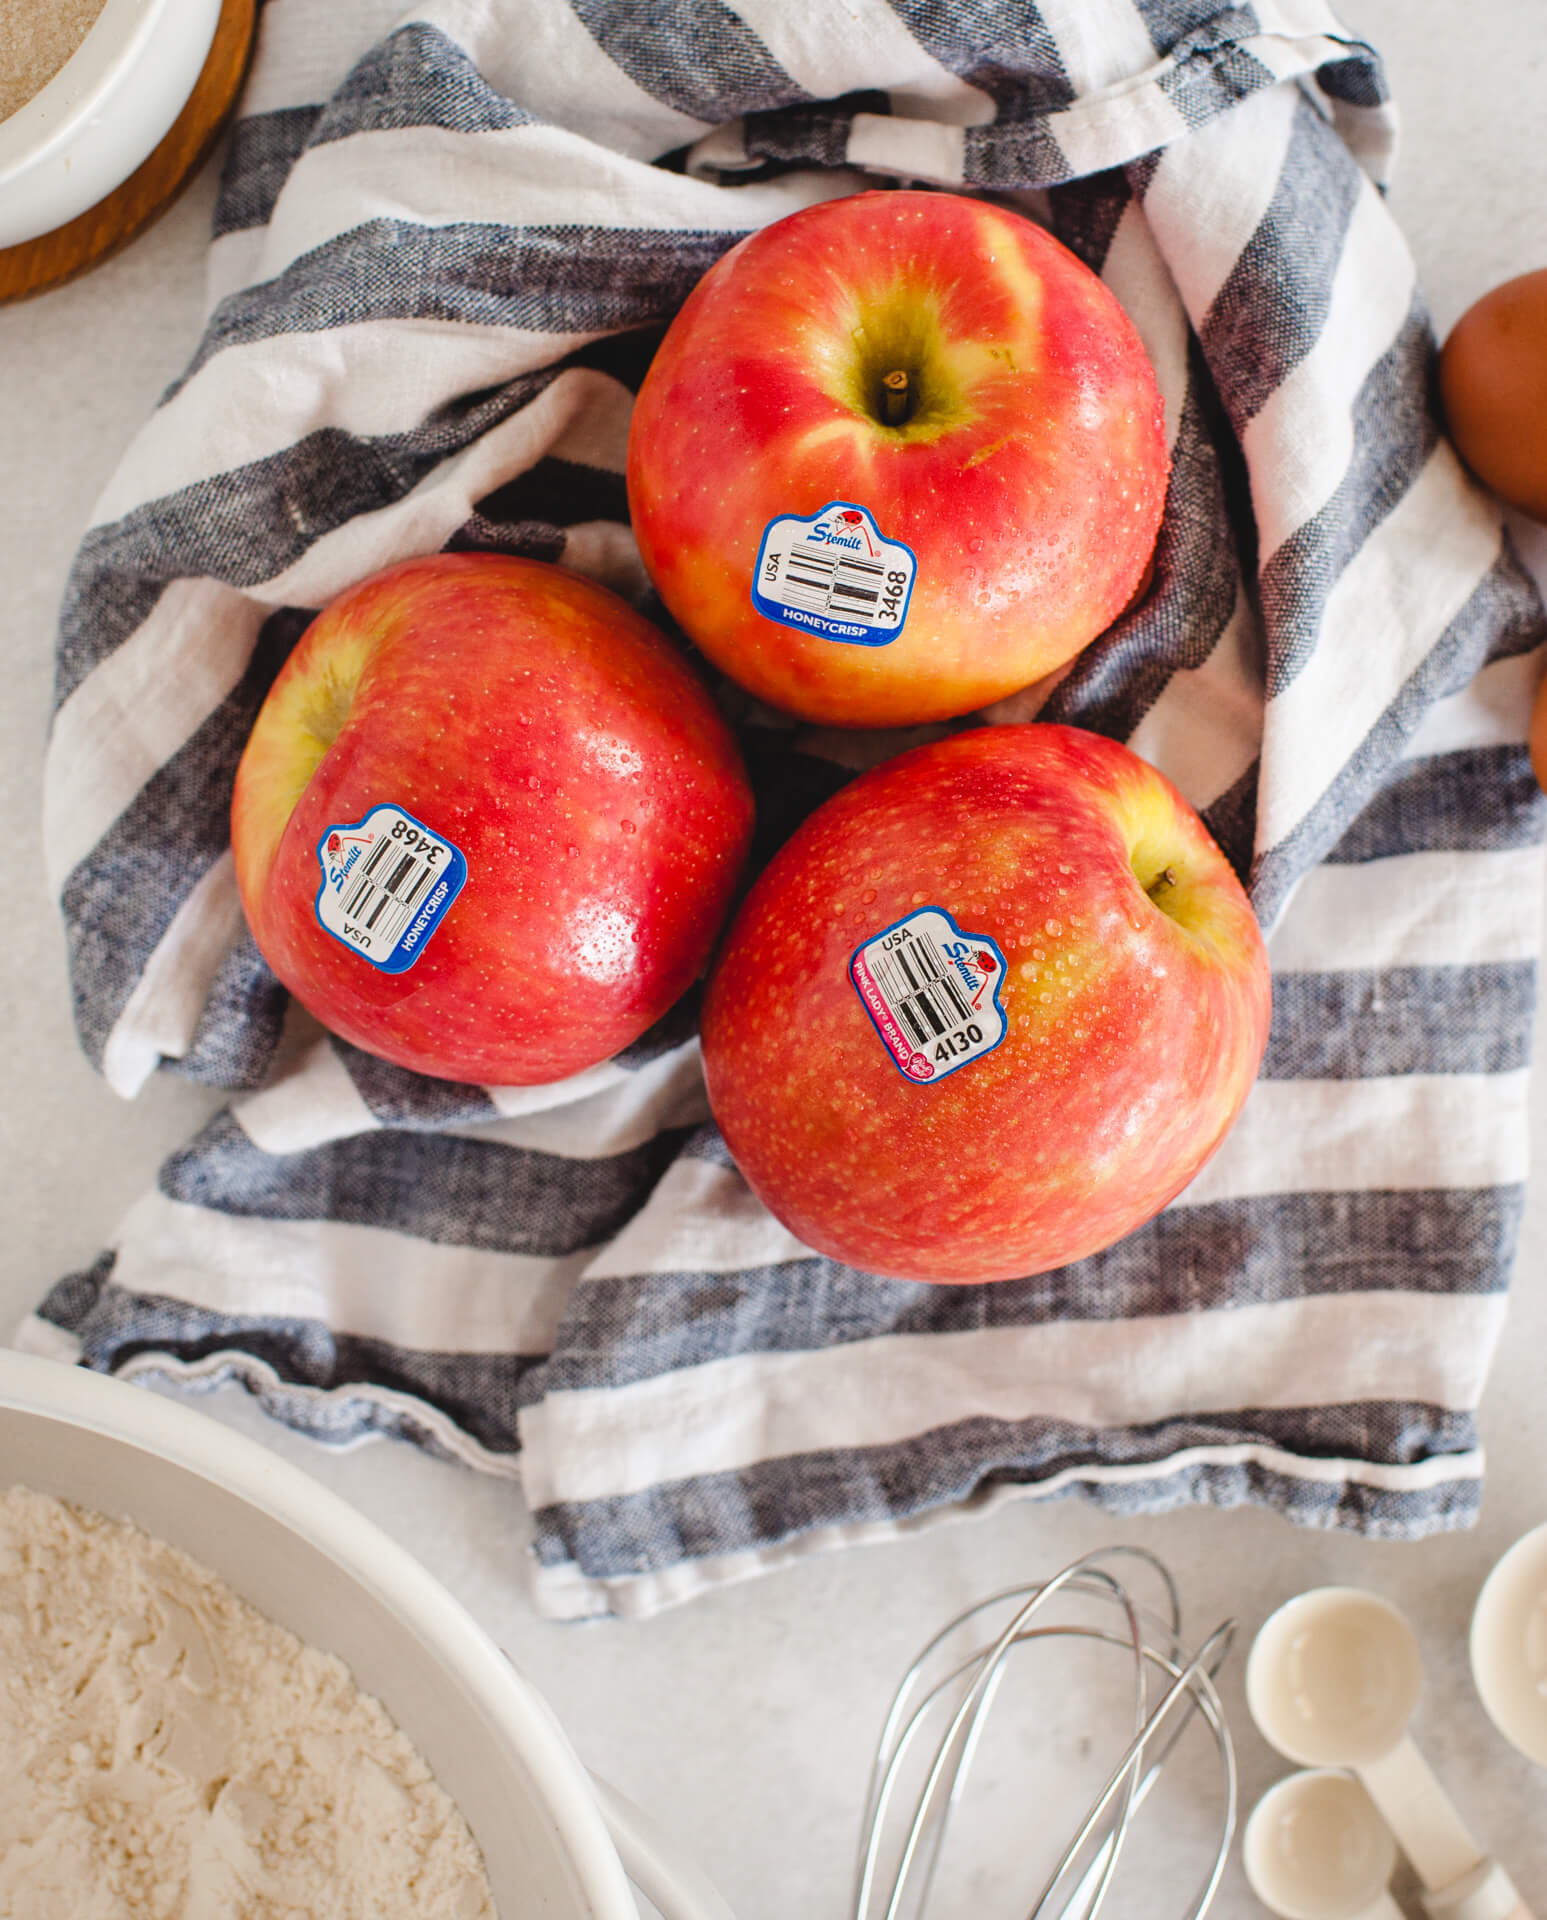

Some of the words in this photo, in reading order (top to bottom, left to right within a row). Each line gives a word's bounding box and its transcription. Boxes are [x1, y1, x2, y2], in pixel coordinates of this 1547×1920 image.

[807, 523, 863, 550] Stemilt
[764, 553, 782, 582] USA
[879, 571, 907, 622] 3468
[783, 608, 868, 637] HONEYCRISP
[391, 820, 445, 865] 3468
[329, 846, 362, 894] Stemilt
[342, 922, 372, 948] USA
[401, 881, 449, 952] HONEYCRISP
[882, 928, 914, 951] USA
[941, 942, 980, 991] Stemilt
[854, 961, 871, 988] PINK
[883, 1022, 910, 1060] BRAND
[934, 1023, 983, 1062] 4130
